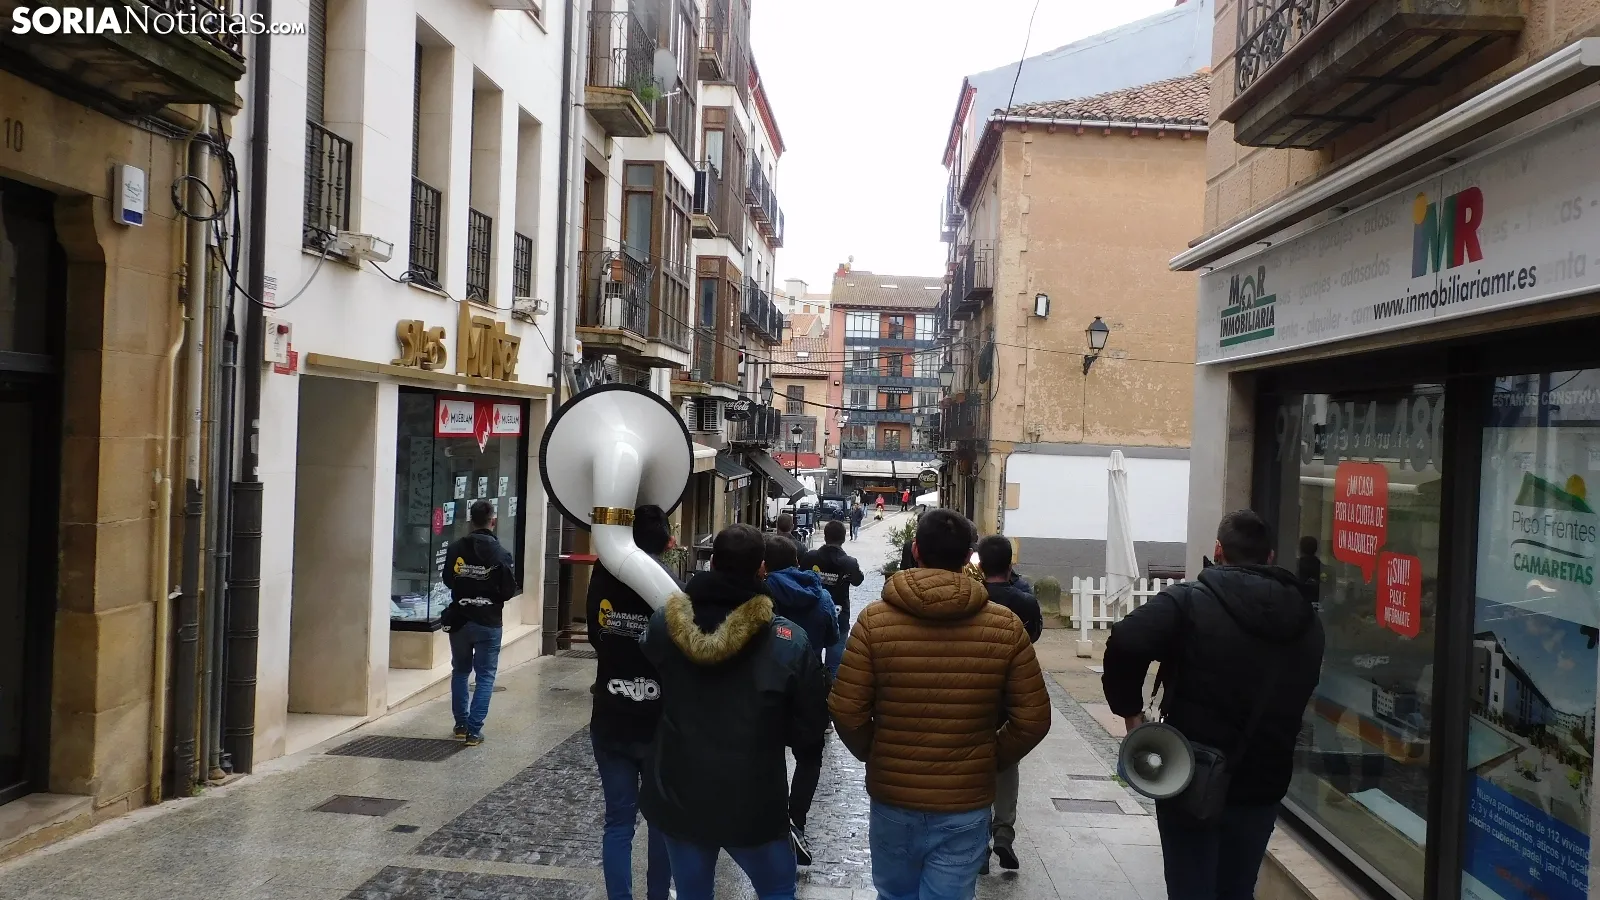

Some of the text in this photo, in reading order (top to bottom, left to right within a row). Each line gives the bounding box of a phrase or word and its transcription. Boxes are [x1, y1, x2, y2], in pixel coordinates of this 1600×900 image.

[4, 117, 24, 153] 10
[1340, 252, 1391, 287] adosados
[1373, 265, 1537, 320] www.inmobiliariamr.es
[1220, 305, 1275, 338] INMOBILIARIA
[1307, 308, 1341, 337] alquiler
[1492, 393, 1539, 408] ESTAMOS
[1324, 400, 1376, 463] 214
[1358, 475, 1374, 496] CASA
[1335, 501, 1385, 528] POR LA CUOTA DE
[1511, 510, 1596, 543] Pico Frentes
[1338, 529, 1378, 556] UN ALQUILER?
[1513, 552, 1594, 586] CAMARETAS
[1389, 588, 1407, 607] PASA E
[606, 611, 649, 622] CHARANGA
[1477, 787, 1496, 806] Nueva
[1497, 801, 1535, 829] promoción
[1536, 822, 1545, 834] de
[1547, 827, 1560, 843] 112
[1468, 813, 1491, 833] piscina
[1492, 828, 1520, 851] cubierta,
[1545, 860, 1569, 884] jardín,
[1471, 799, 1477, 811] 2,
[1478, 803, 1483, 813] 3
[1483, 807, 1487, 818] y
[1488, 809, 1493, 820] 4
[1493, 813, 1536, 847] dormitorios,
[1560, 854, 1566, 866] y
[1529, 866, 1542, 882] etc.
